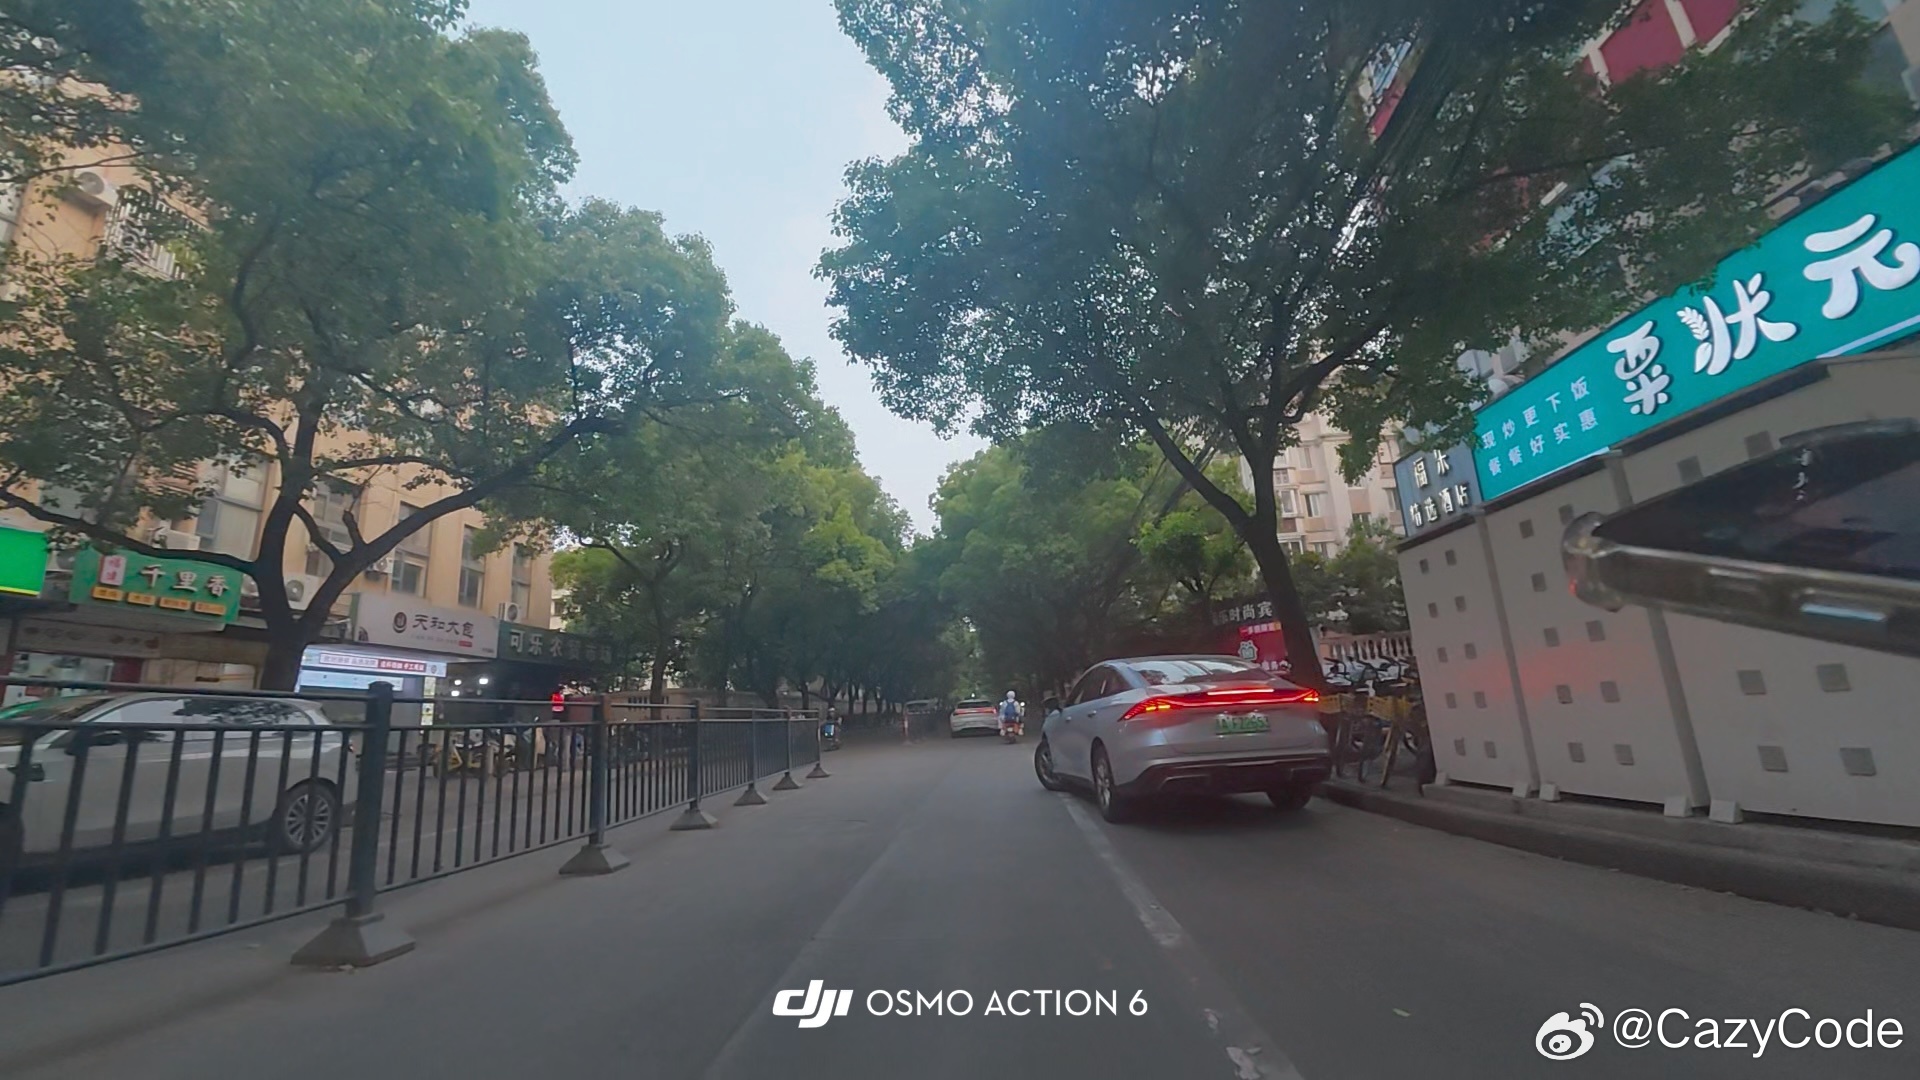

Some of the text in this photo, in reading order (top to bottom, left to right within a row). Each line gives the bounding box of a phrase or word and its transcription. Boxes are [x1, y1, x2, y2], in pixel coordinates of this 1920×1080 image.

[1481, 376, 1590, 449] 现炒更下饭
[1489, 407, 1598, 476] 餐餐好实惠
[139, 564, 229, 597] 千里香
[412, 614, 474, 639] 天和大包
